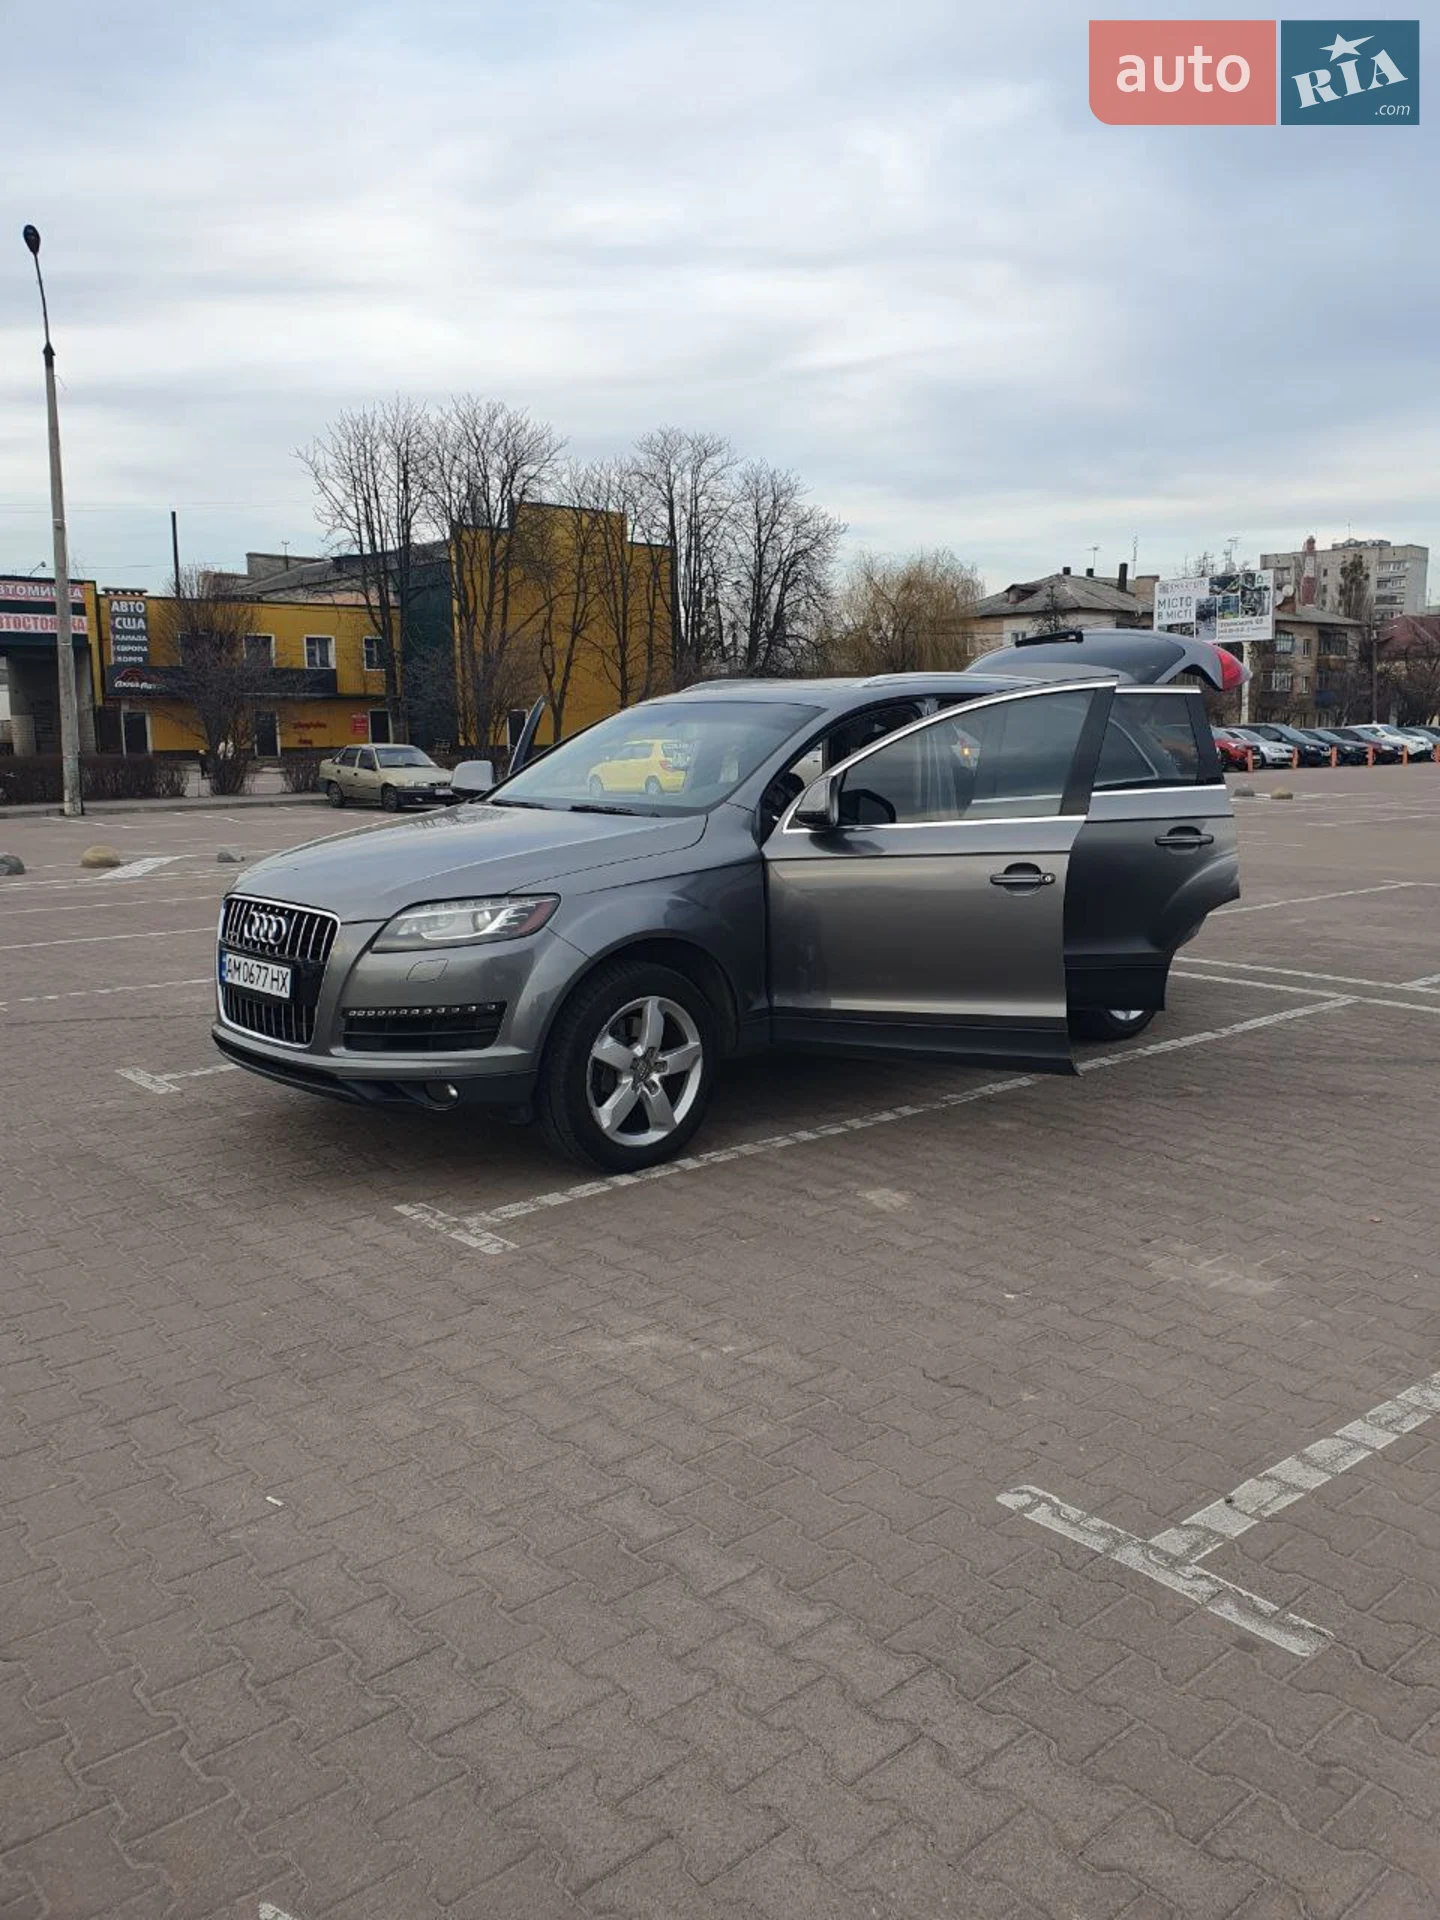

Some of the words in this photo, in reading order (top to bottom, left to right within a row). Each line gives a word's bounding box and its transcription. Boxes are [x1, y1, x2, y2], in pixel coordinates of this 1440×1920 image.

[0, 584, 83, 598] ВТОМИА
[111, 601, 145, 613] АВТО
[0, 615, 86, 632] ВТОСТОЯКА
[115, 617, 146, 630] США
